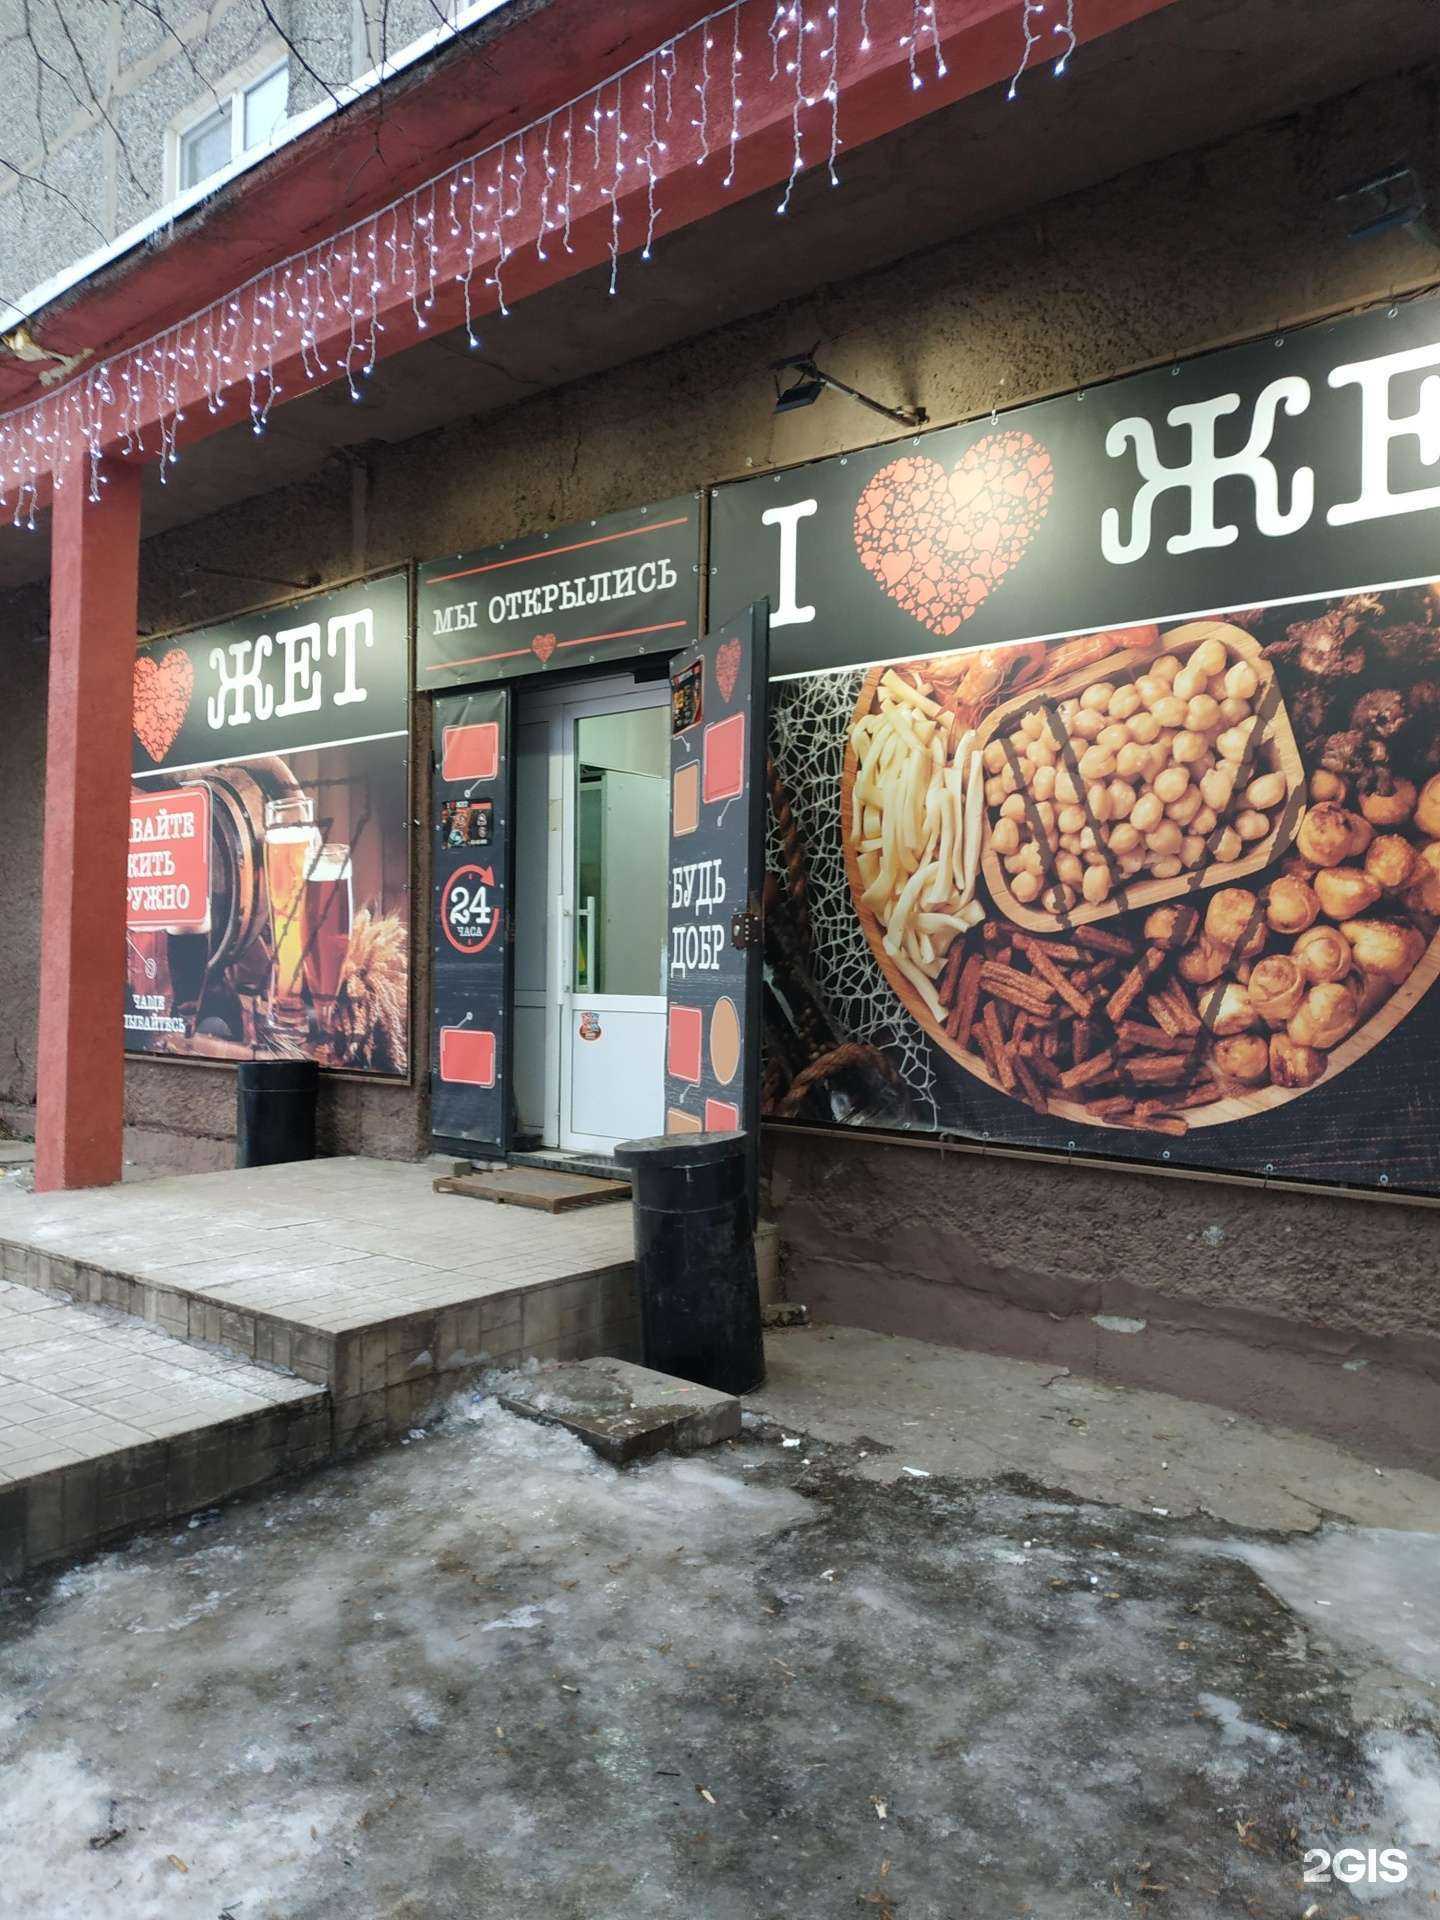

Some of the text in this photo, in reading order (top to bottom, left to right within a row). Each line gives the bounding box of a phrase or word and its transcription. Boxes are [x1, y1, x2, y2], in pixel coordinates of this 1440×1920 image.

[761, 342, 1440, 628] I ЖЕ
[432, 558, 678, 636] МЫ ОТКРЫЛИСЬ
[207, 608, 374, 730] ЖЕТ
[128, 808, 195, 843] ВАЙТЕ
[126, 883, 190, 912] УЖНО
[449, 886, 491, 925] 24
[671, 858, 726, 916] БУДЬ
[456, 926, 483, 937] ЧАСА
[671, 924, 725, 979] ДОБР
